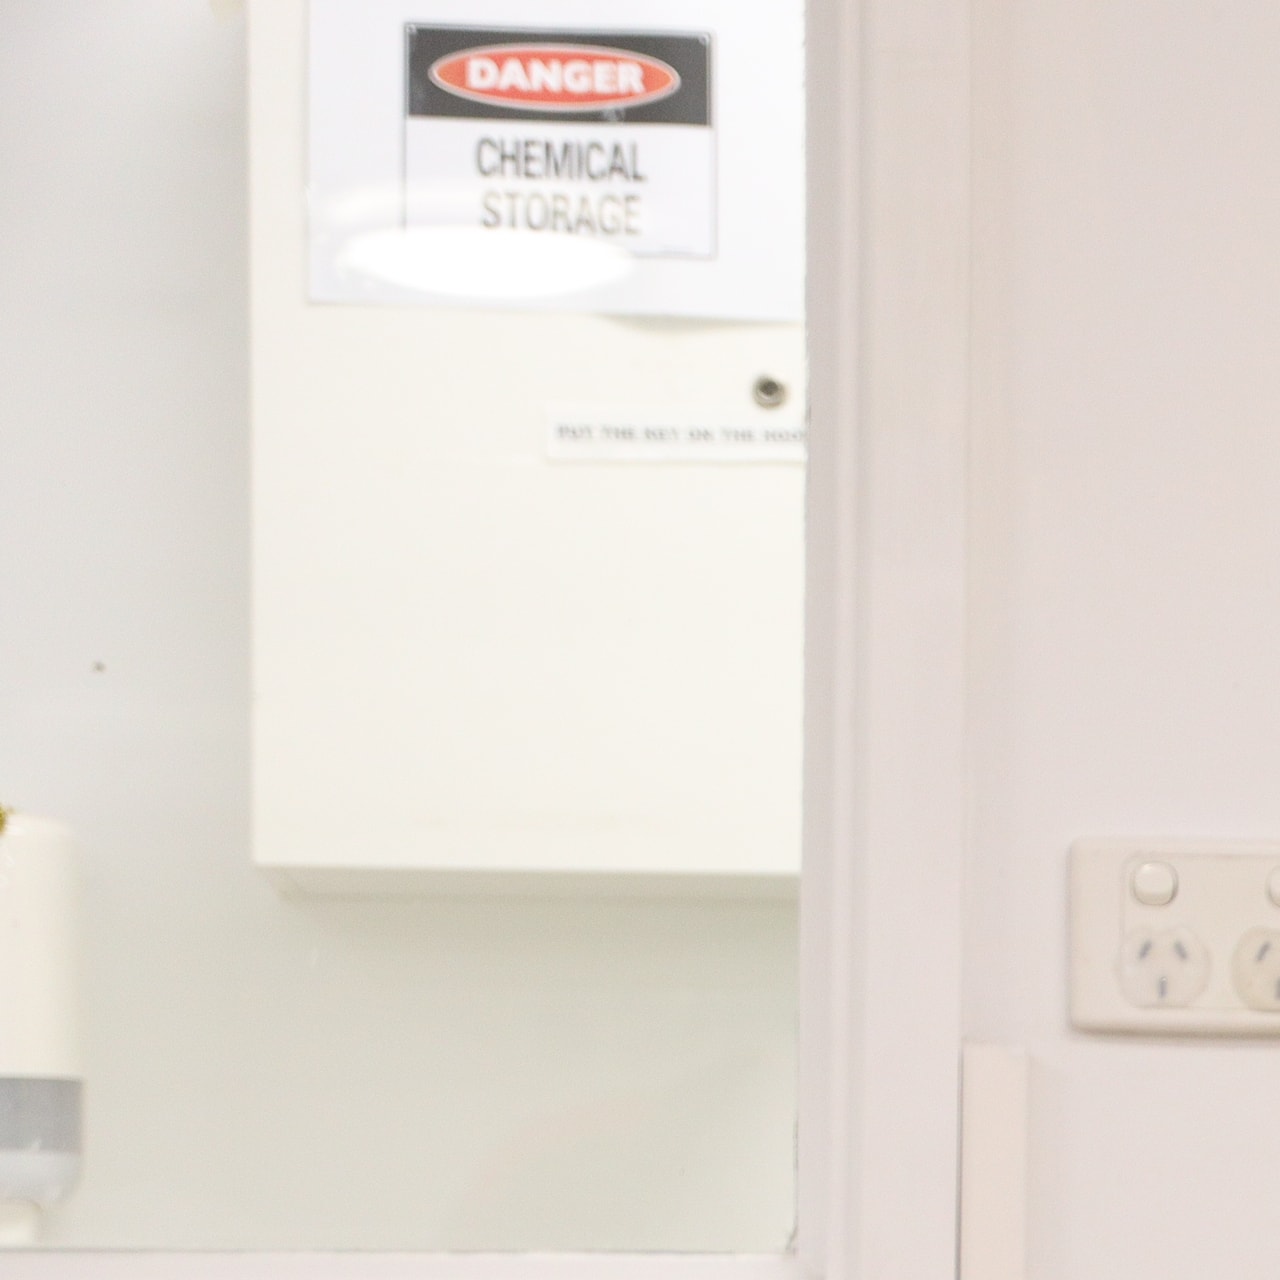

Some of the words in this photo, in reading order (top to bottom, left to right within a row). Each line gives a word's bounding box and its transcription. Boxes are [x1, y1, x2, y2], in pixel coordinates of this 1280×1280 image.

[465, 57, 646, 95] DANGER
[474, 136, 647, 183] CHEMICAL
[480, 191, 643, 236] STORAGE
[557, 424, 593, 441] PUT
[601, 424, 635, 441] THE
[643, 425, 679, 442] KEY
[722, 427, 755, 443] THE
